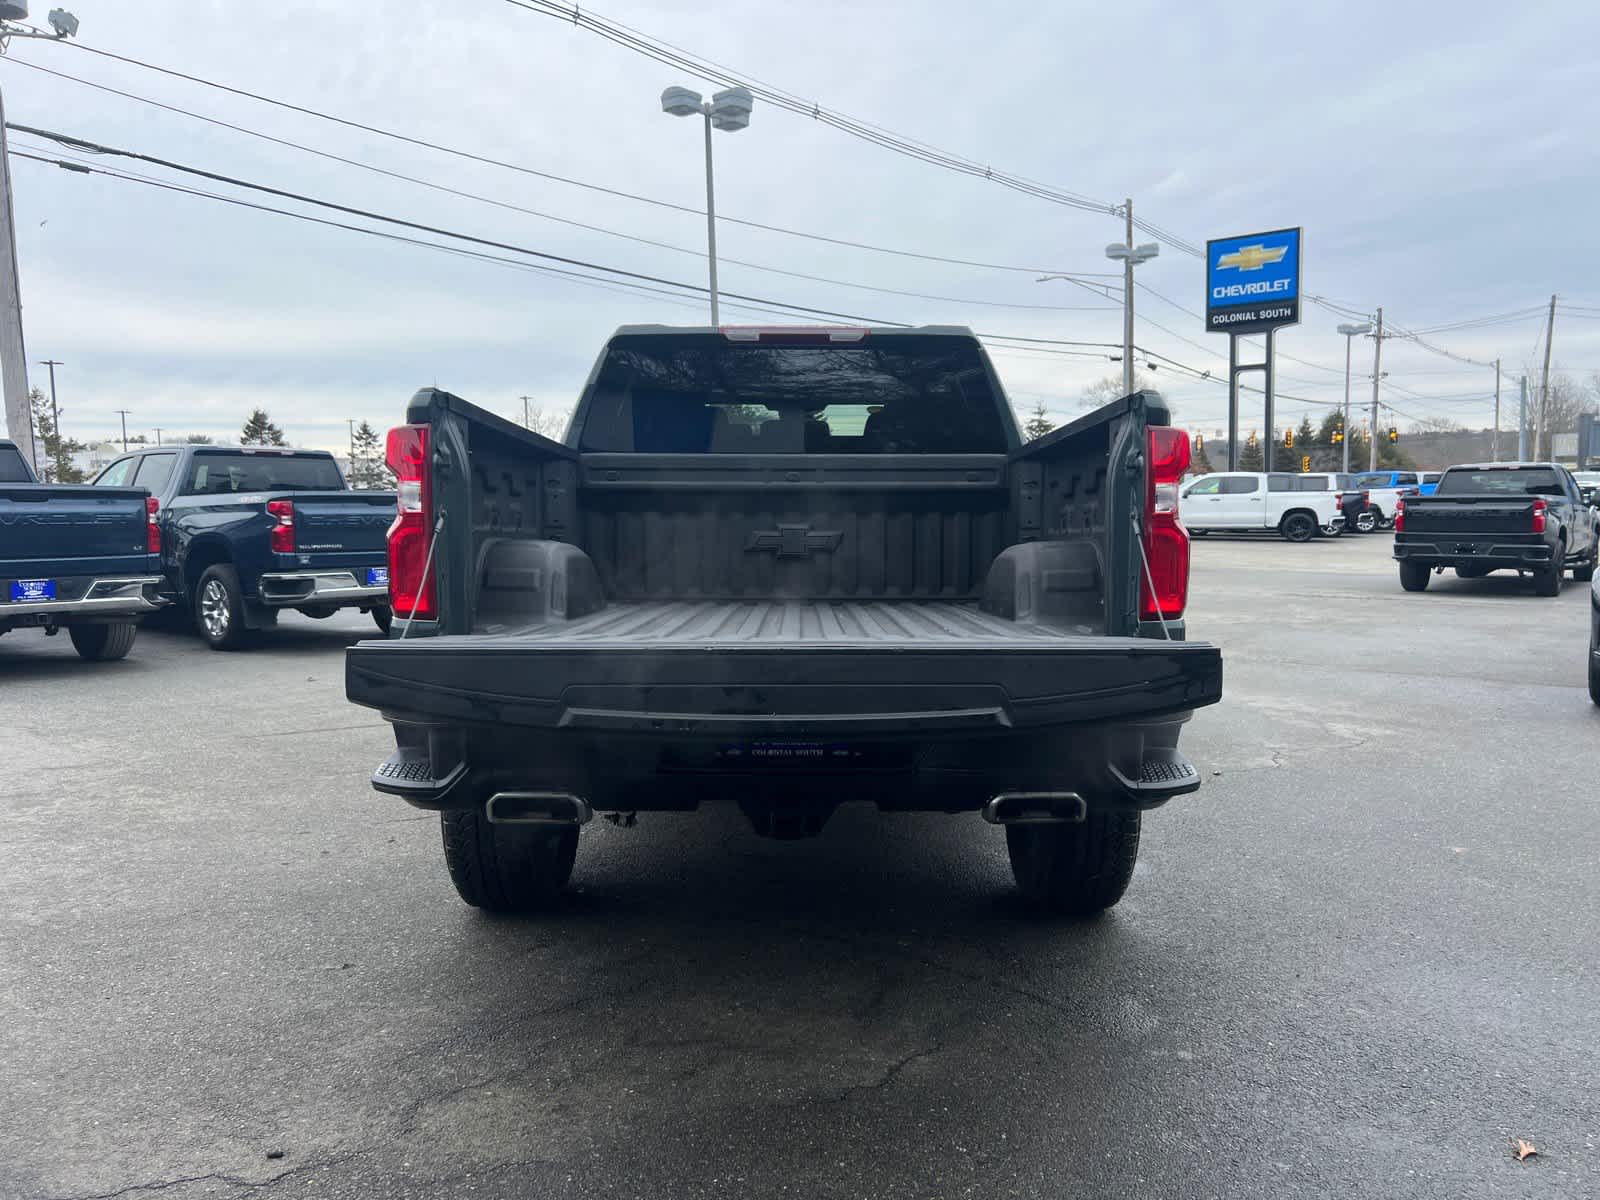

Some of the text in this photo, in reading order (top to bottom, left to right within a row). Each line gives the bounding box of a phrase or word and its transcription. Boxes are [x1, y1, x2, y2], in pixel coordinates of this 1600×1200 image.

[1213, 279, 1291, 298] CHEVROLET
[1212, 307, 1291, 324] COLONIAL SOUTH
